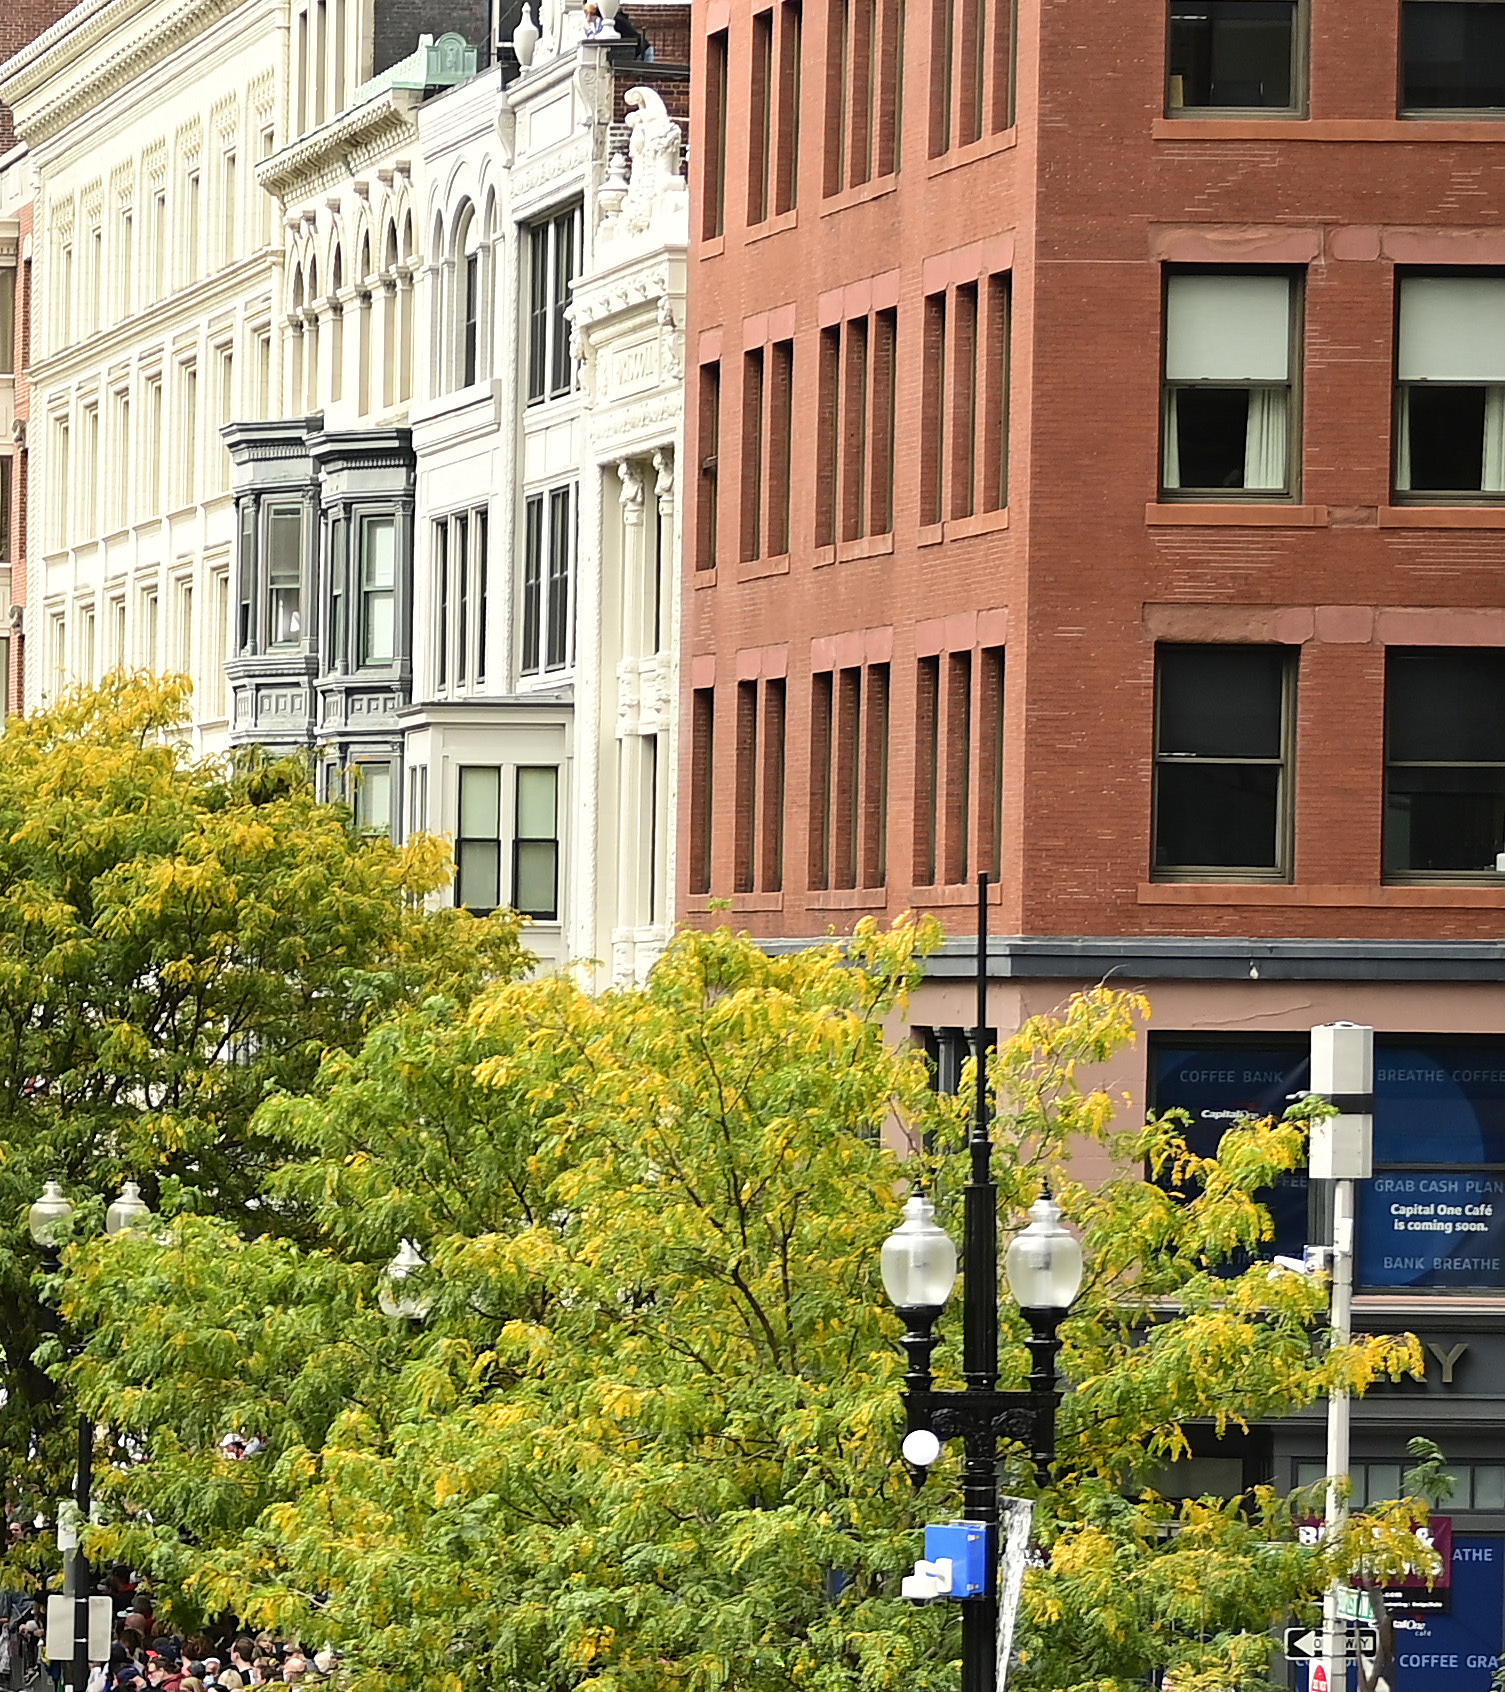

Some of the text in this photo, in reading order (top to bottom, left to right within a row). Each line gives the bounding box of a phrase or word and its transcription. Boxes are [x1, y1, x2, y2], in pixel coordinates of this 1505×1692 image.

[1179, 1070, 1284, 1083] COFFEE BANK
[1378, 1070, 1445, 1082] BREATHE
[1375, 1180, 1415, 1192] GRAB
[1419, 1180, 1458, 1193] CASH
[1390, 1203, 1493, 1216] Capital One Café
[1394, 1218, 1489, 1233] is coming soon.
[1383, 1256, 1500, 1270] BANK BREATHE
[1399, 1654, 1499, 1668] COFFEE GRA
